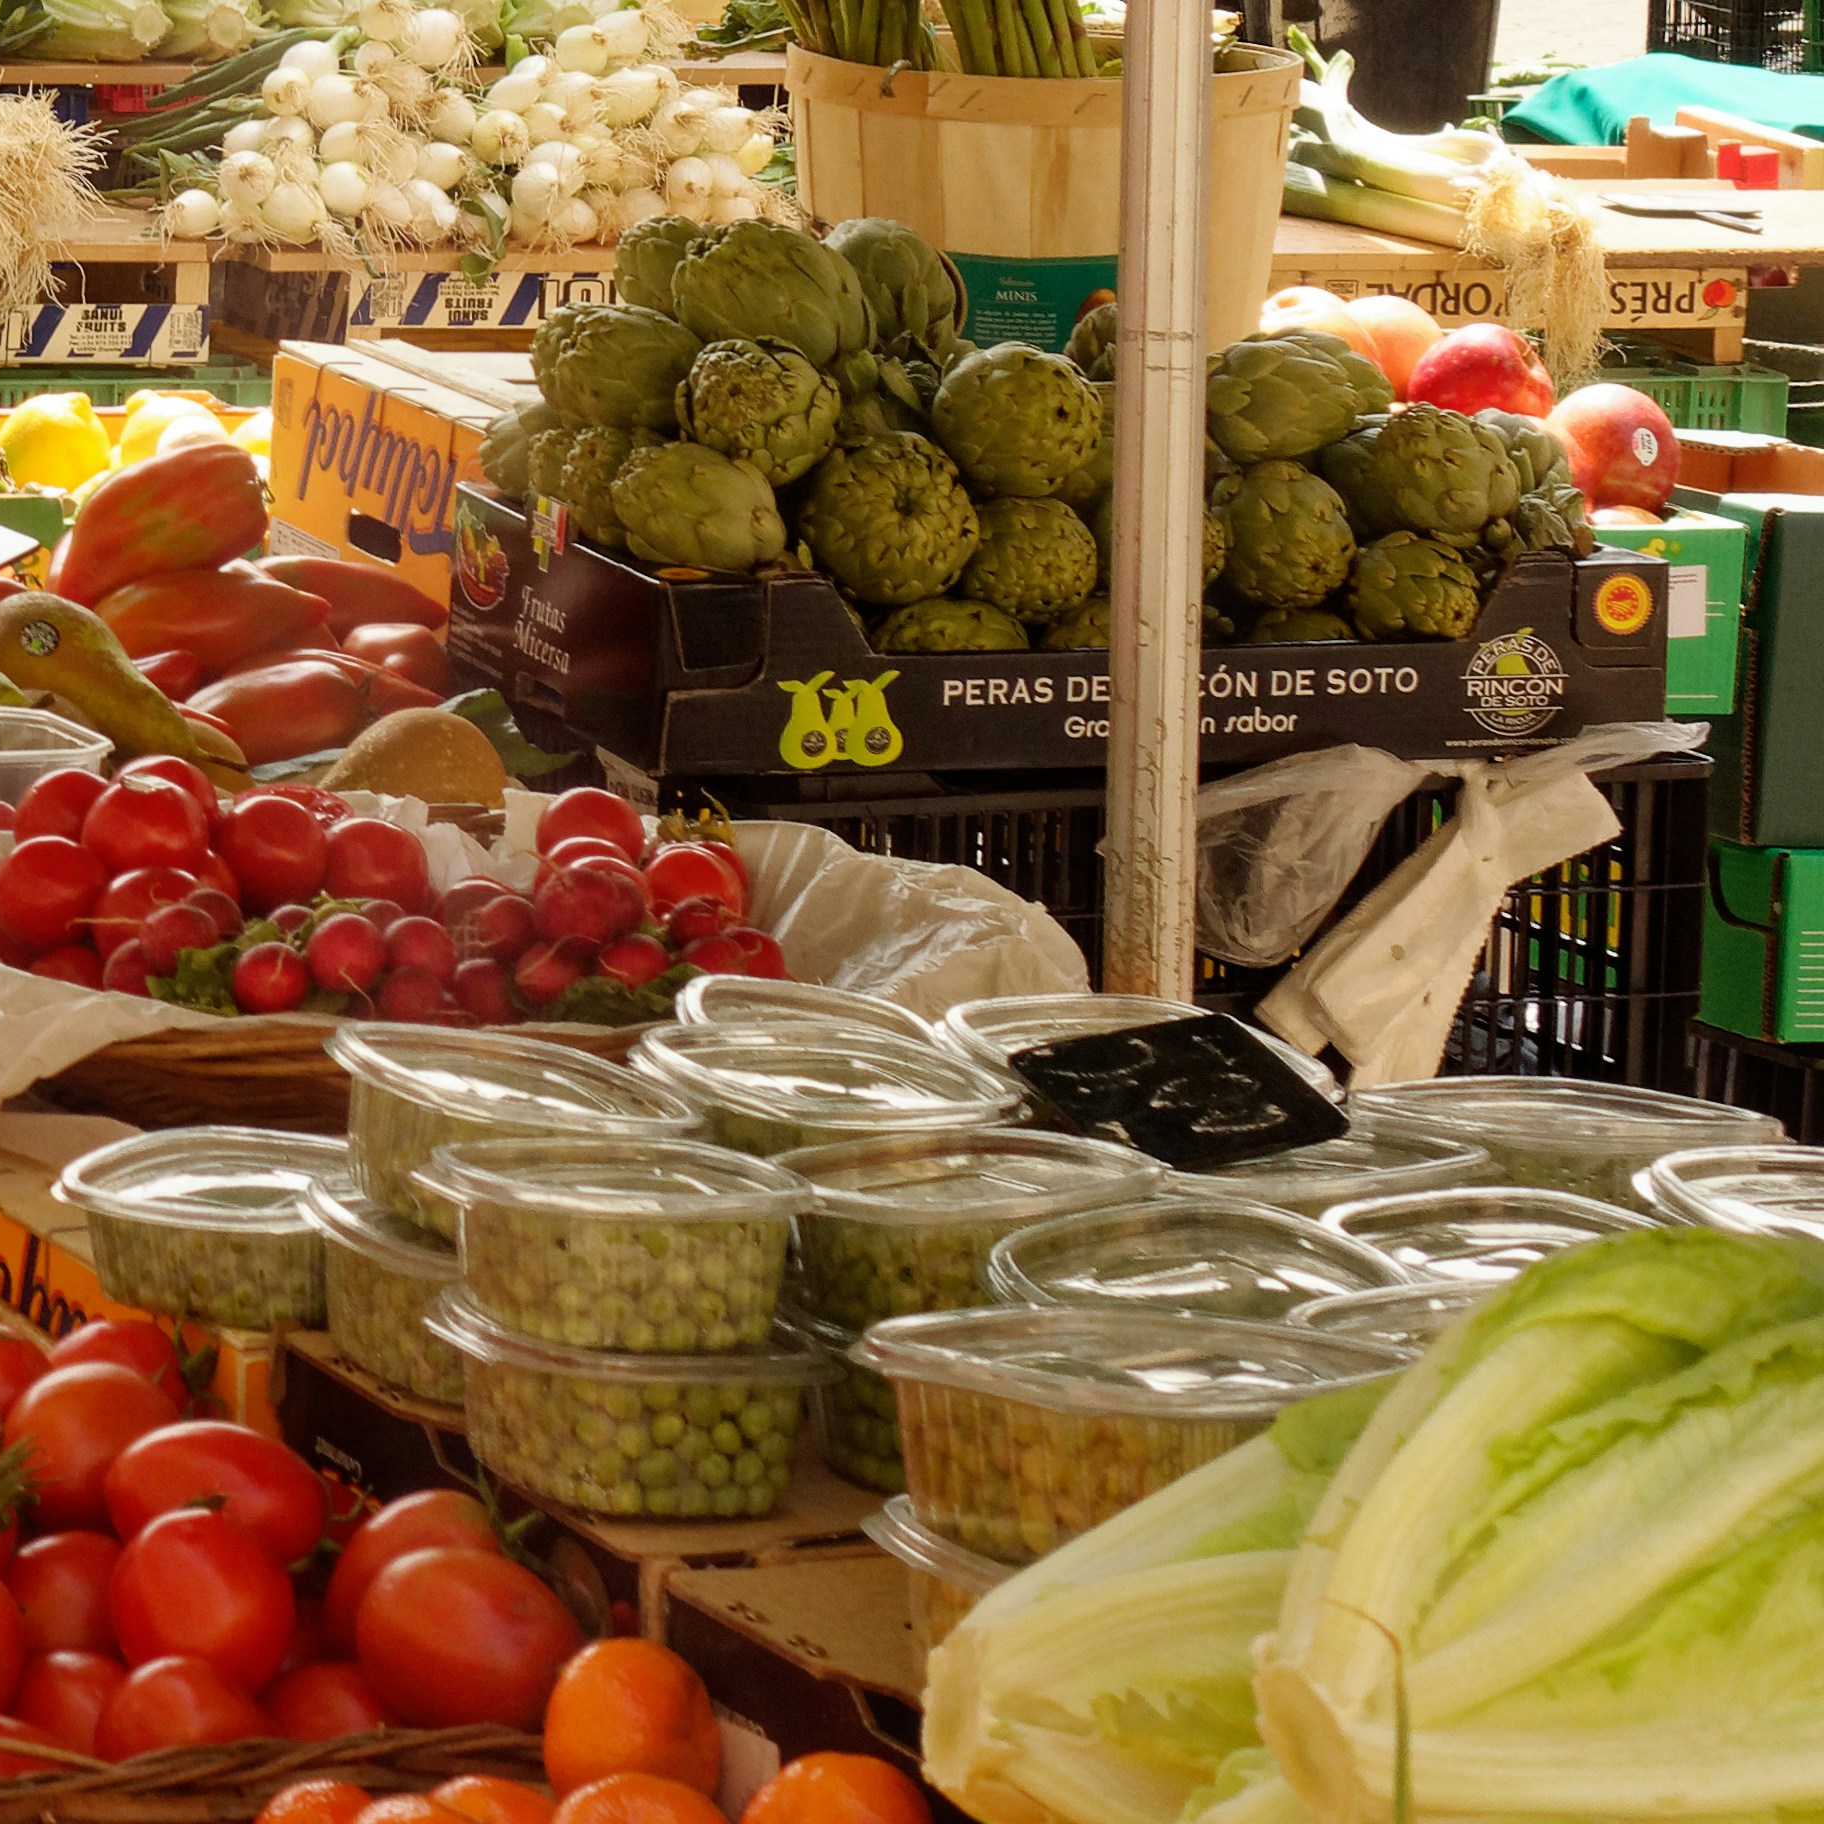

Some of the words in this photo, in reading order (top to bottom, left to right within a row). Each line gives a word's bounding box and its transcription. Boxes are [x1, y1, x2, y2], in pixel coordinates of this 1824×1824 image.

[996, 290, 1038, 302] MINIS
[445, 297, 493, 310] FRUITS
[81, 308, 123, 321] SANUI
[447, 309, 489, 322] SANUI
[76, 321, 127, 333] FRUITS
[1472, 635, 1535, 676] PERAS
[1533, 645, 1558, 675] DE
[942, 677, 1053, 706] PERAS
[1066, 675, 1110, 703] DE
[1270, 668, 1316, 698] DE
[1326, 666, 1419, 694] SOTO
[1466, 675, 1565, 697] RINCÓN
[1480, 695, 1502, 708] DE
[1504, 695, 1549, 707] SOTO
[1223, 707, 1298, 734] sabor
